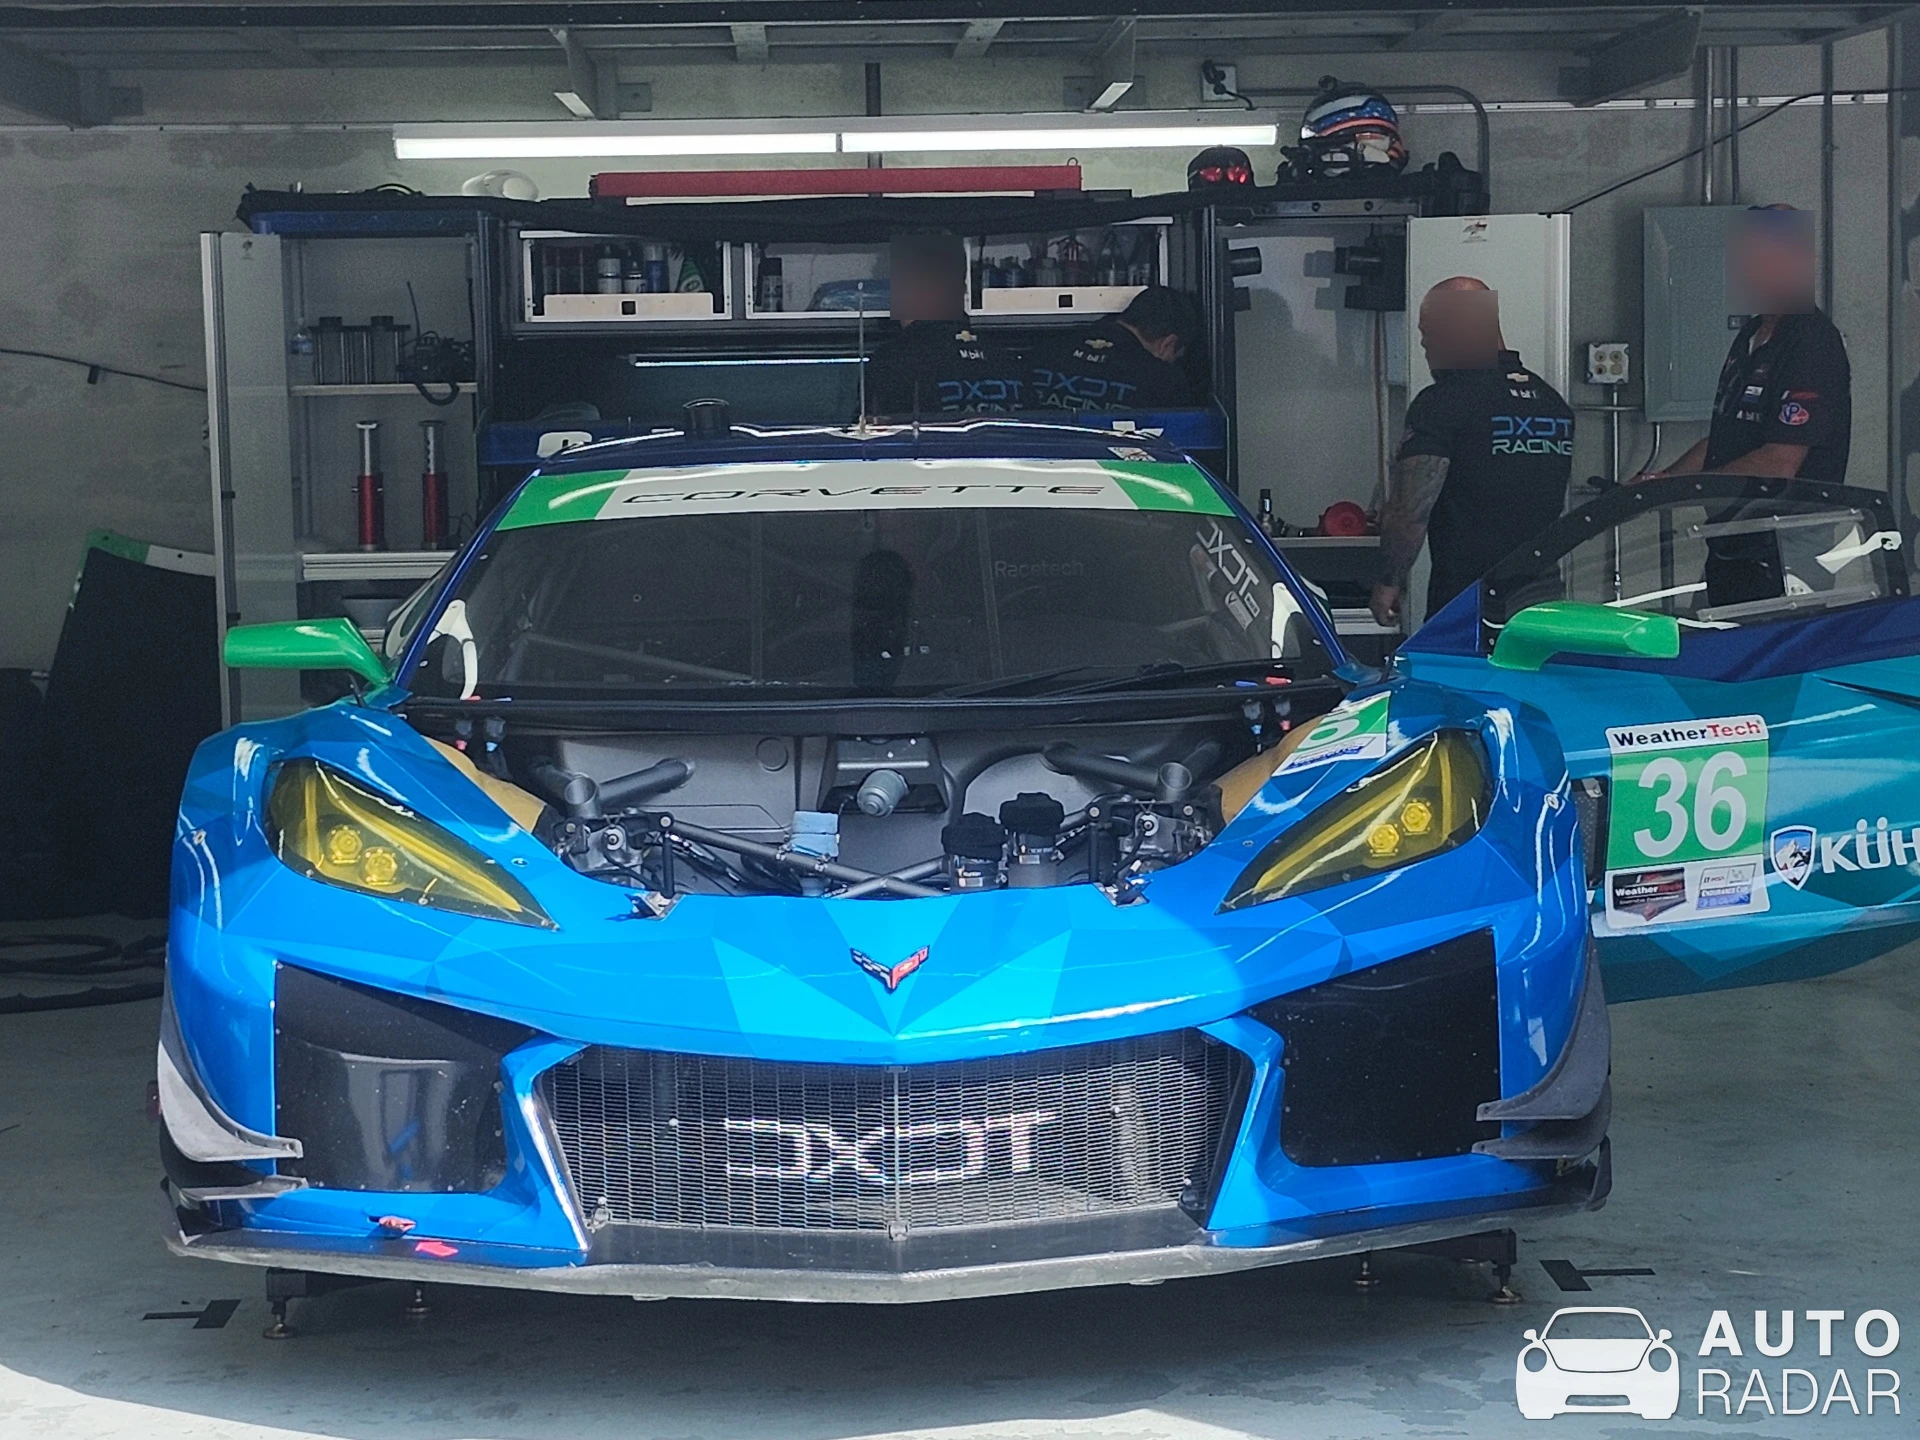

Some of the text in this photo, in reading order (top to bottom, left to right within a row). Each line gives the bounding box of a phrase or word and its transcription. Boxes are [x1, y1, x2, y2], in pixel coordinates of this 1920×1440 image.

[938, 379, 1025, 402] DXDT
[1033, 368, 1137, 401] DXDT
[1037, 389, 1133, 412] ACIN
[1491, 415, 1571, 438] DXDT
[1491, 438, 1573, 455] RACING
[621, 484, 1106, 505] CORVETTE
[1196, 514, 1260, 597] DXDT
[994, 560, 1084, 578] Racetech
[1614, 721, 1761, 747] WeatherTech
[1633, 751, 1748, 858] 36
[1615, 880, 1683, 897] Weather
[724, 1107, 1058, 1184] DXDT
